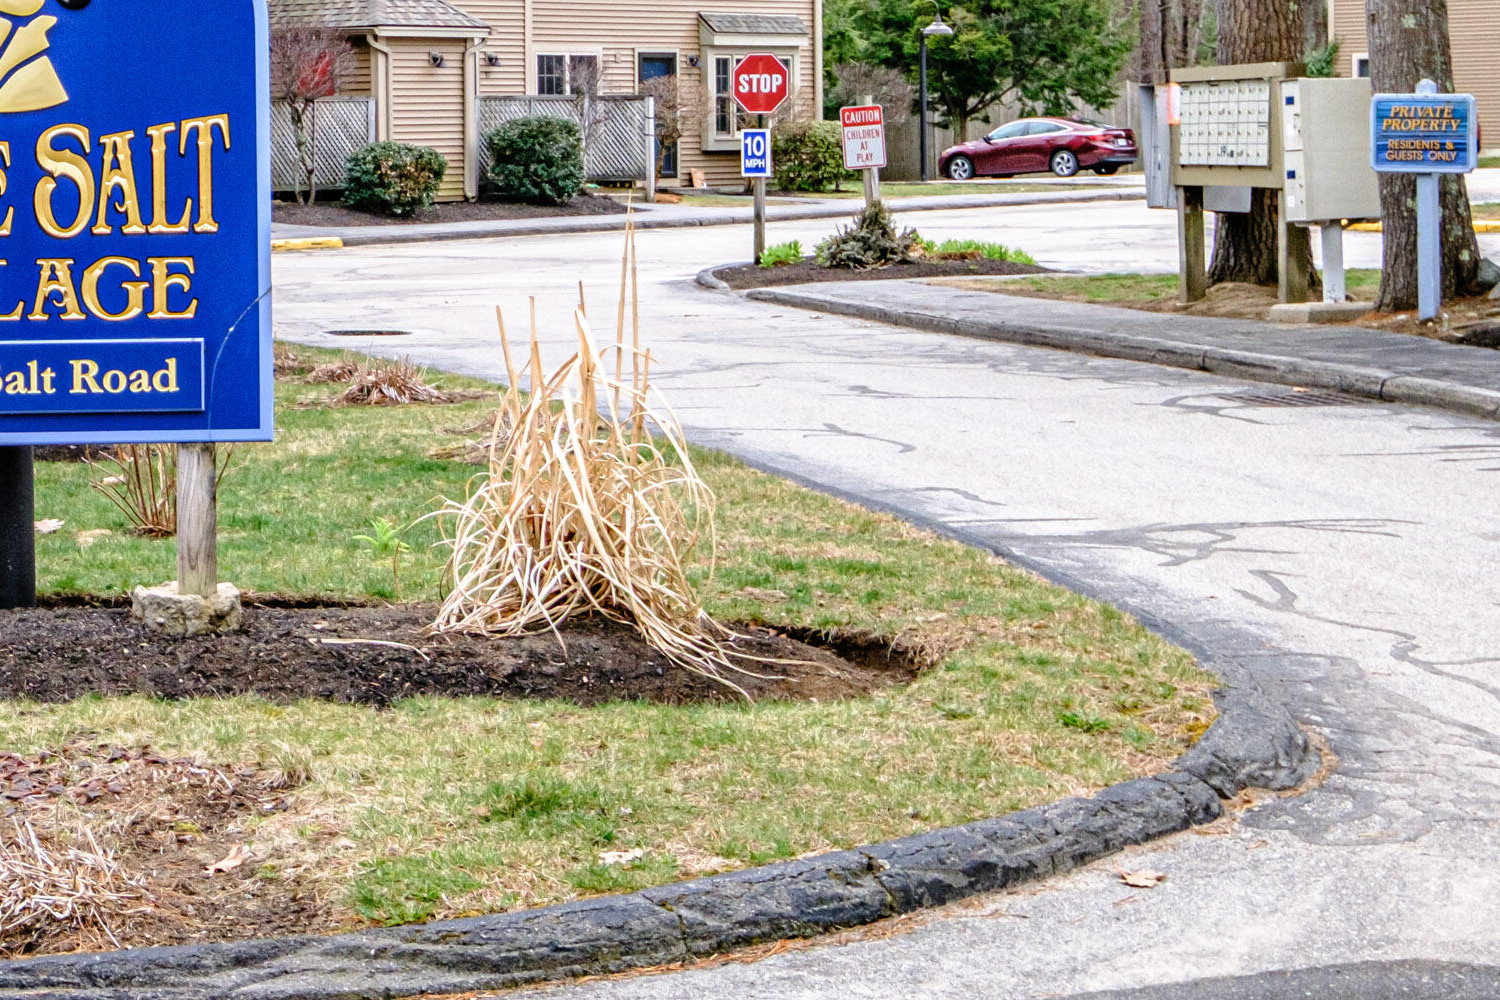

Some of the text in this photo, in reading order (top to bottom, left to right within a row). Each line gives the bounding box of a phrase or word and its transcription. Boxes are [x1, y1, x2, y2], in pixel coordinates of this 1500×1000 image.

[739, 74, 782, 93] STOP
[844, 110, 880, 123] CAUTION
[1390, 106, 1453, 117] PRIVATE
[1382, 119, 1460, 131] PROPERTY
[846, 129, 880, 140] CHILDREN
[744, 136, 764, 156] 10
[861, 141, 868, 150] AT
[1388, 140, 1454, 150] RESIDENTS &
[856, 153, 873, 163] PLAY
[1386, 151, 1456, 160] GUESTS ONLY
[745, 158, 765, 168] MPH
[34, 113, 231, 239] SALT
[68, 357, 180, 394] Road
